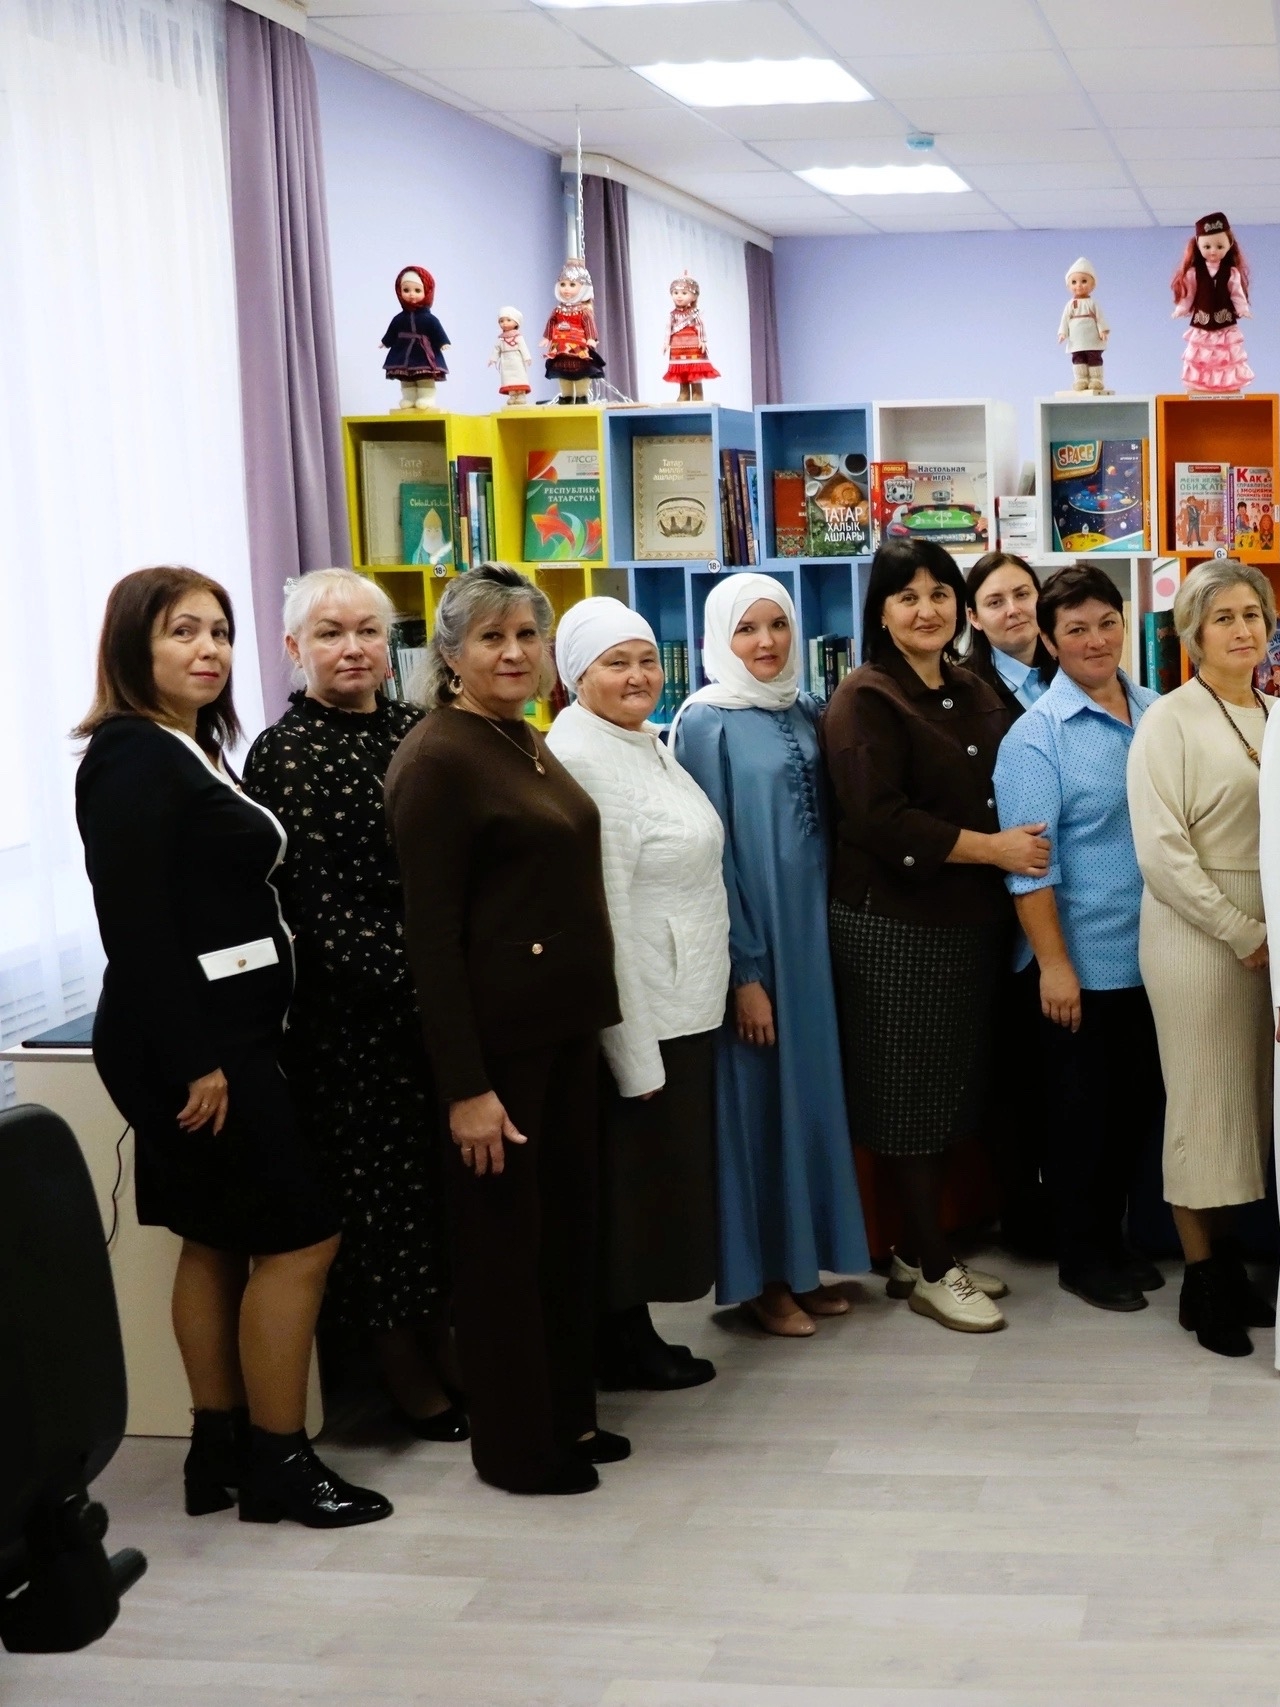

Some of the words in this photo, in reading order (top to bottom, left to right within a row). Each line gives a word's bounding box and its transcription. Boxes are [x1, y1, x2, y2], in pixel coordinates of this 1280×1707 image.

[1058, 444, 1095, 466] SPACE
[917, 465, 966, 473] Настольная
[544, 486, 600, 495] РЕСПУБЛИКА
[548, 495, 596, 503] ТАТАРСТАН
[822, 506, 863, 522] ТАТАР
[827, 521, 860, 532] ХАЛЫК
[824, 532, 865, 542] АШЛАРЫ
[1217, 550, 1226, 559] 6+
[435, 566, 446, 575] 18+
[709, 562, 720, 570] 18+
